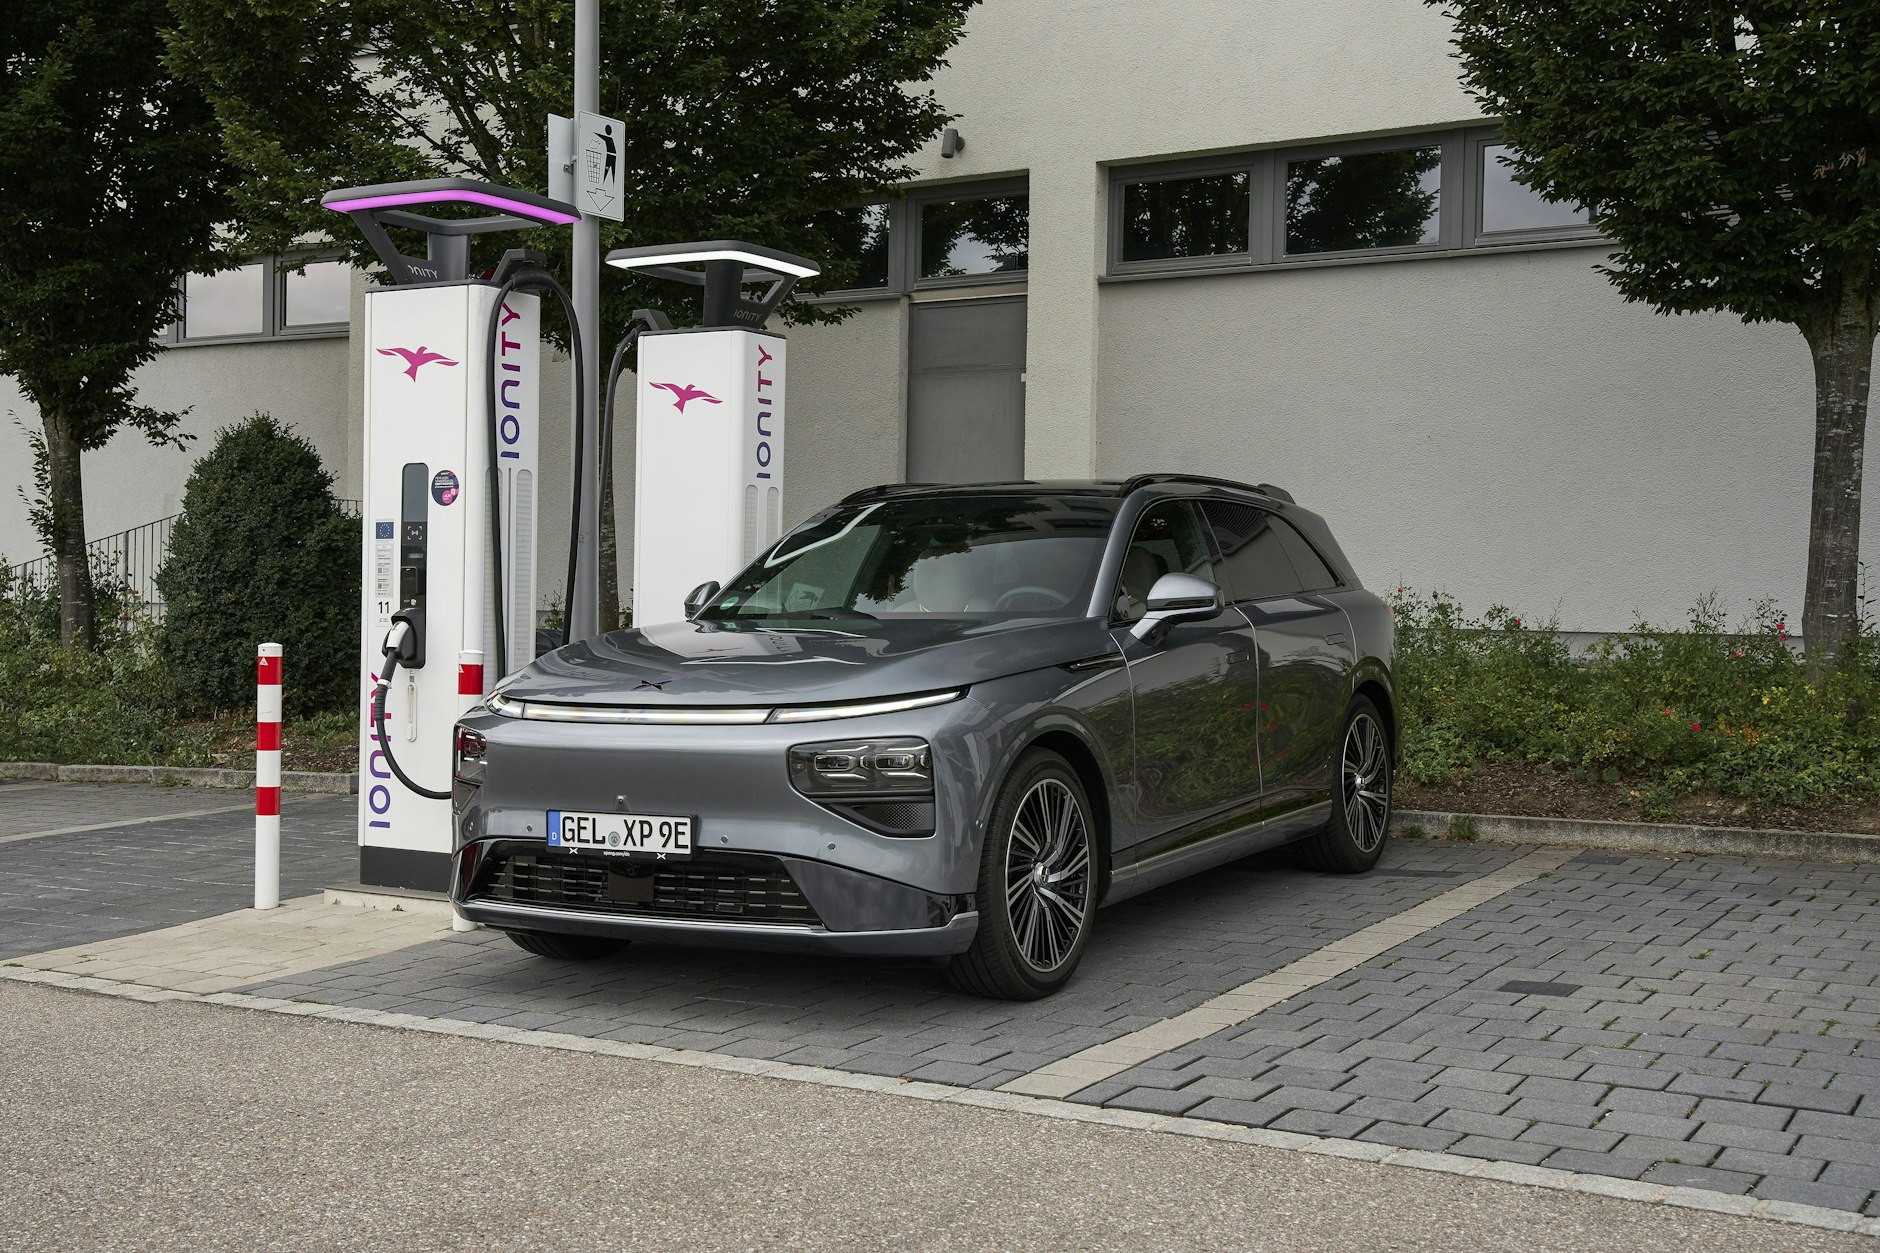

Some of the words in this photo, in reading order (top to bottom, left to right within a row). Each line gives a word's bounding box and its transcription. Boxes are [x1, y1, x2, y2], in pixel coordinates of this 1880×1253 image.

[407, 264, 438, 279] NITY
[733, 309, 762, 321] IONITY
[500, 302, 521, 459] IONITY
[756, 344, 773, 479] IONITY
[378, 601, 390, 614] 11
[551, 832, 557, 840] D
[562, 816, 606, 845] GEL
[623, 819, 653, 847] XP
[659, 821, 689, 849] 9E
